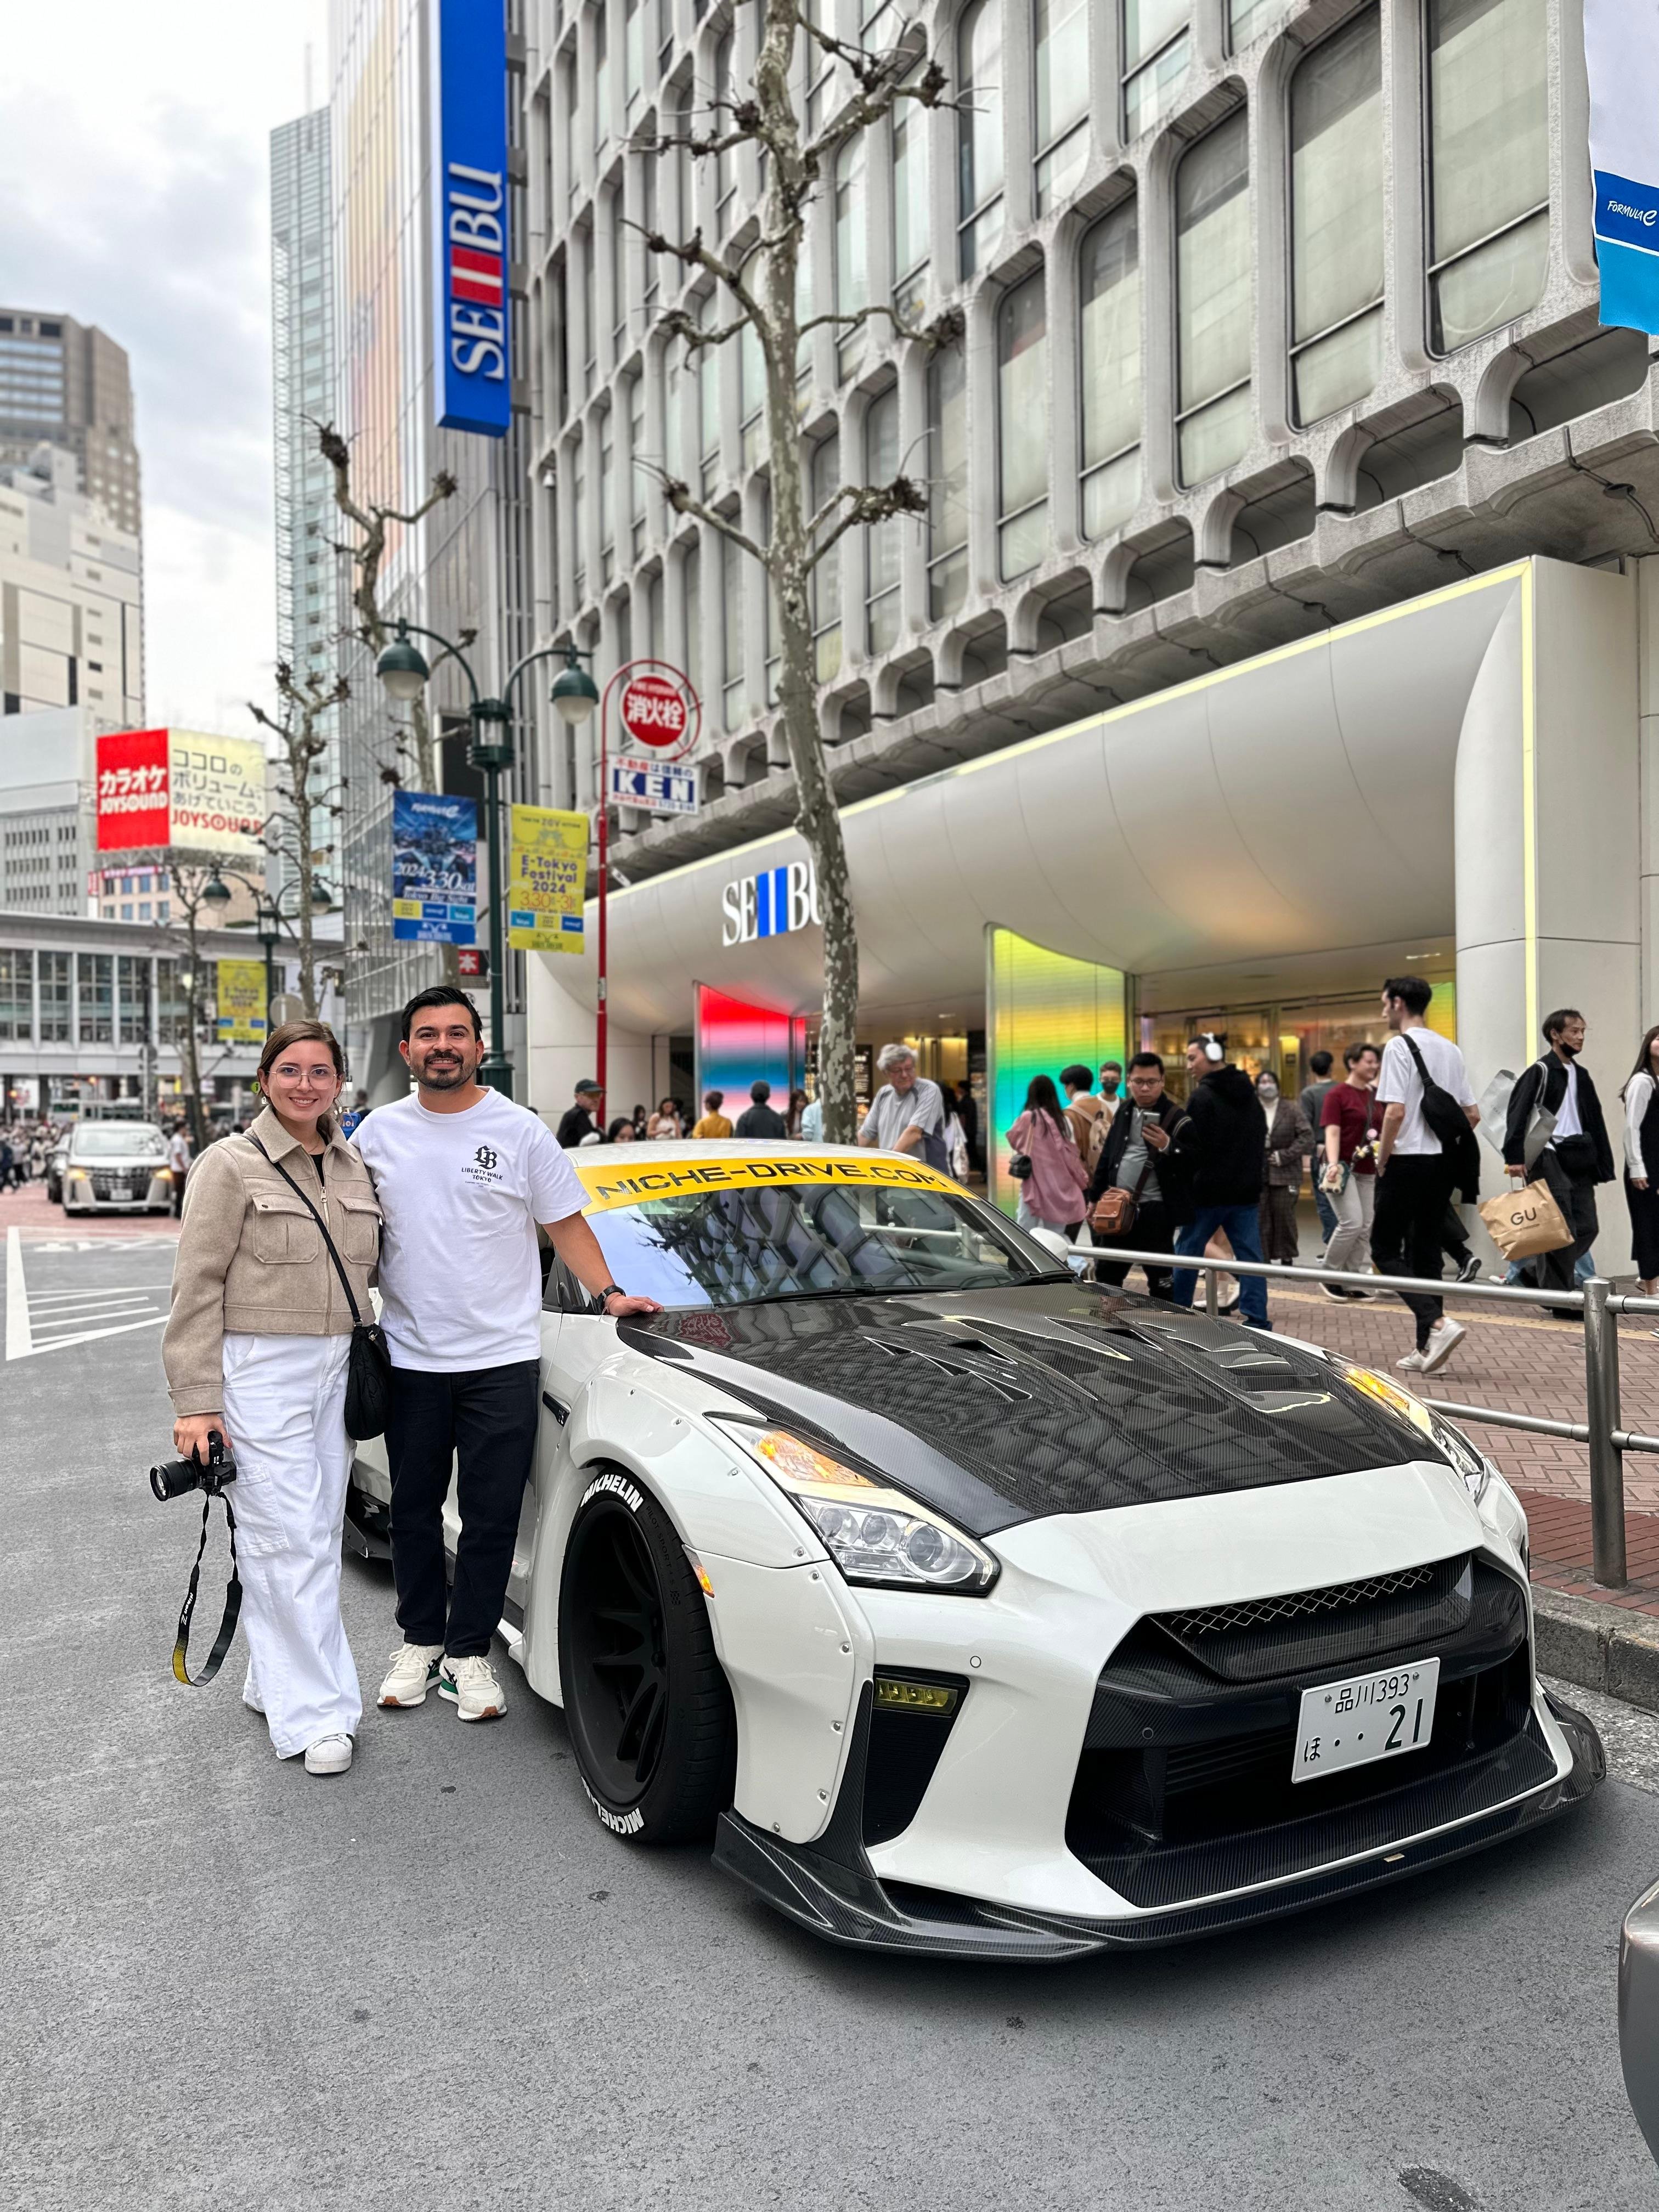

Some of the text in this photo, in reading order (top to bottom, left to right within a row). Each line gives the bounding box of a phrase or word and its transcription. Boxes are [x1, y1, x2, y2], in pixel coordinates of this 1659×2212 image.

[449, 162, 504, 380] SEIBU
[627, 693, 682, 730] 消火栓
[173, 749, 242, 776] ココロの
[100, 765, 166, 795] カラオケ
[619, 770, 690, 802] KEN
[521, 855, 578, 872] E-Tokyo
[521, 867, 578, 883] Festival
[532, 881, 566, 894] 2024
[461, 1167, 503, 1181] LIBERTY WALK
[472, 1174, 492, 1182] TOKYO
[596, 1163, 948, 1200] NICHE-DRIVE.COM
[1510, 1207, 1537, 1226] GU
[580, 1474, 644, 1513] MICHELIN
[646, 1505, 659, 1529] PILOT
[1335, 1673, 1409, 1713] 品川 393
[1304, 1698, 1423, 1762] ほ 21
